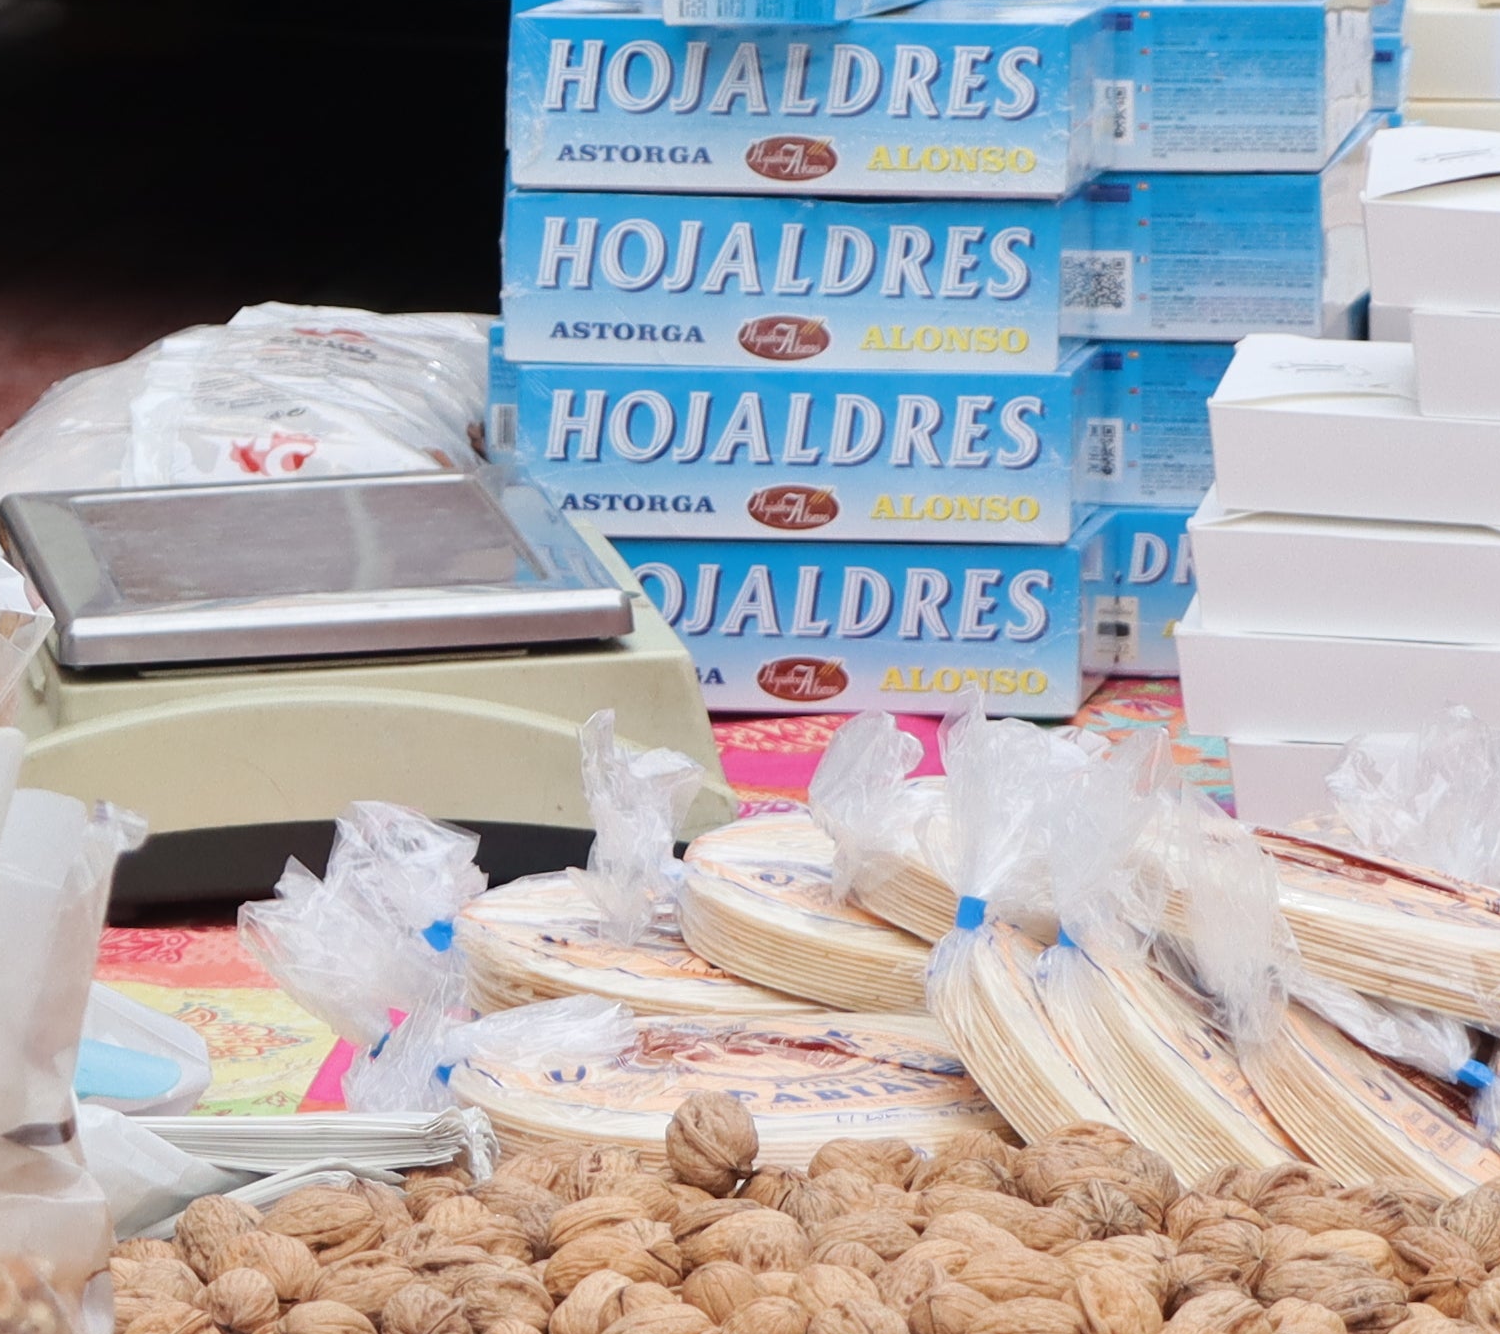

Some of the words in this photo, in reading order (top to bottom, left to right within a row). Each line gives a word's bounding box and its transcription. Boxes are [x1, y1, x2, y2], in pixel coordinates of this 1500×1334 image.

[543, 38, 1041, 120] HOJALDRES
[556, 143, 713, 166] ASTORGA
[865, 145, 1037, 174] ALONSO
[535, 216, 1033, 301] HOJALDRES
[549, 321, 706, 344] ASTORGA
[858, 324, 1030, 354] ALONSO
[544, 389, 1044, 467] HOJALDRES
[560, 492, 716, 514] ASTORGA
[870, 494, 1040, 524] ALONSO
[879, 664, 1050, 695] ALONSO
